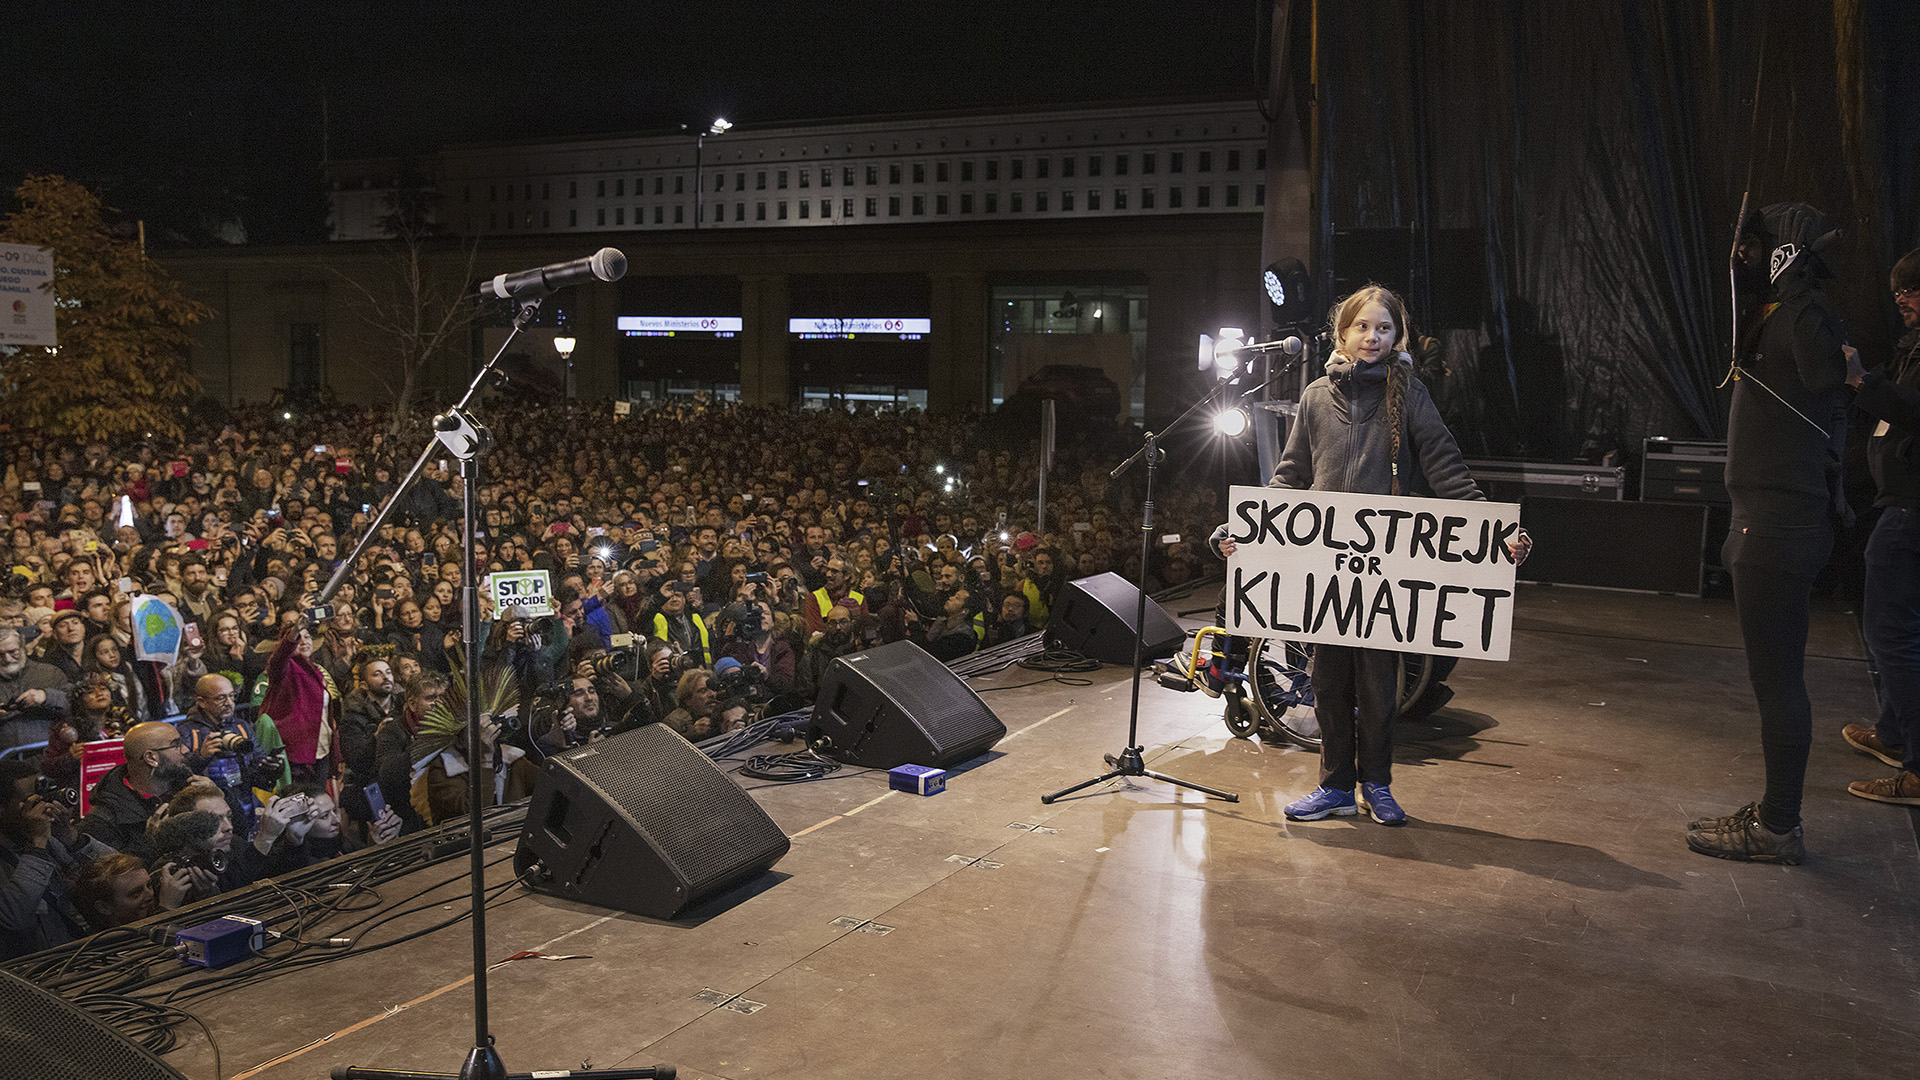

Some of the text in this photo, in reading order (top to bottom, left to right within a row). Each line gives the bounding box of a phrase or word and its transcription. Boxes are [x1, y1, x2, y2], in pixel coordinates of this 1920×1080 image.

[11, 268, 48, 277] CULTURA
[640, 320, 700, 328] Nuevos Ministerios
[1229, 499, 1519, 565] SKOLSTREJK
[1335, 552, 1382, 576] FÖR
[498, 578, 545, 596] STOP
[499, 595, 546, 607] ECOCIDE
[1234, 567, 1512, 652] KLIMATET
